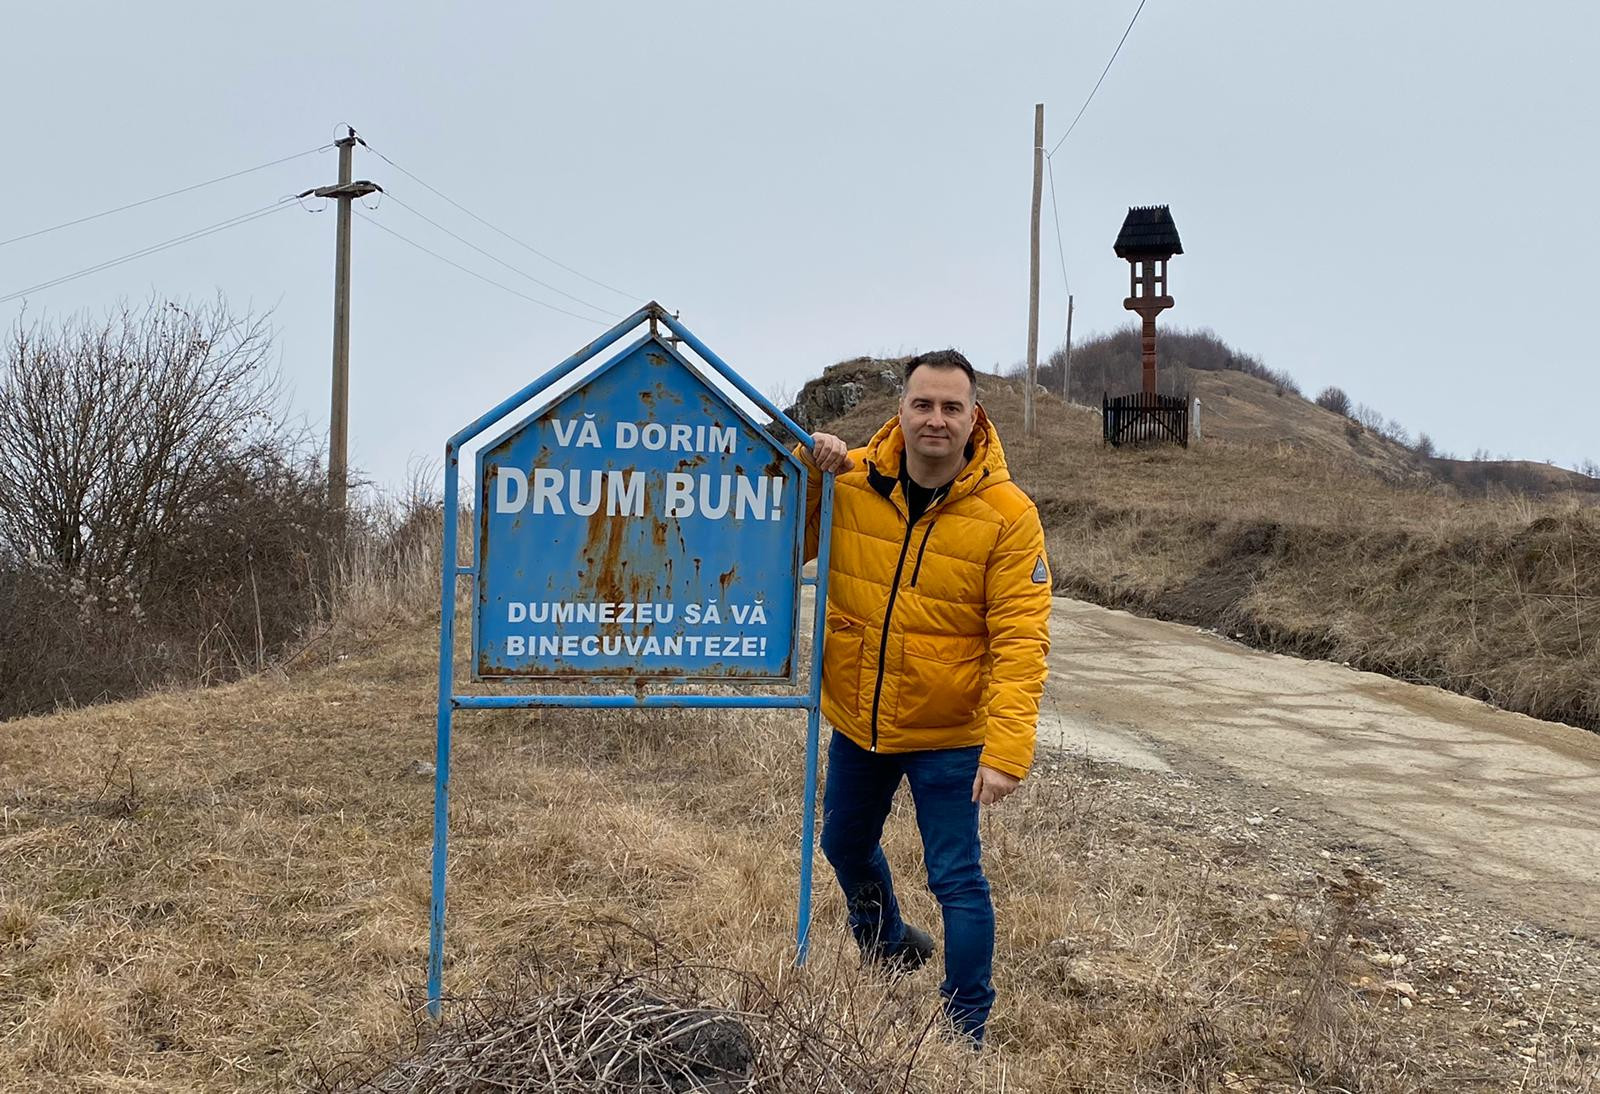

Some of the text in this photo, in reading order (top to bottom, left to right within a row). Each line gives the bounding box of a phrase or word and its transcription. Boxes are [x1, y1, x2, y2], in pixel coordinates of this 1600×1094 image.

[551, 412, 738, 454] VĂ DORIM
[495, 466, 783, 521] DRUM BUN!
[507, 599, 767, 625] DUMNEZEU SĂ VĂ
[506, 635, 767, 657] BINECUVANTEZE!
